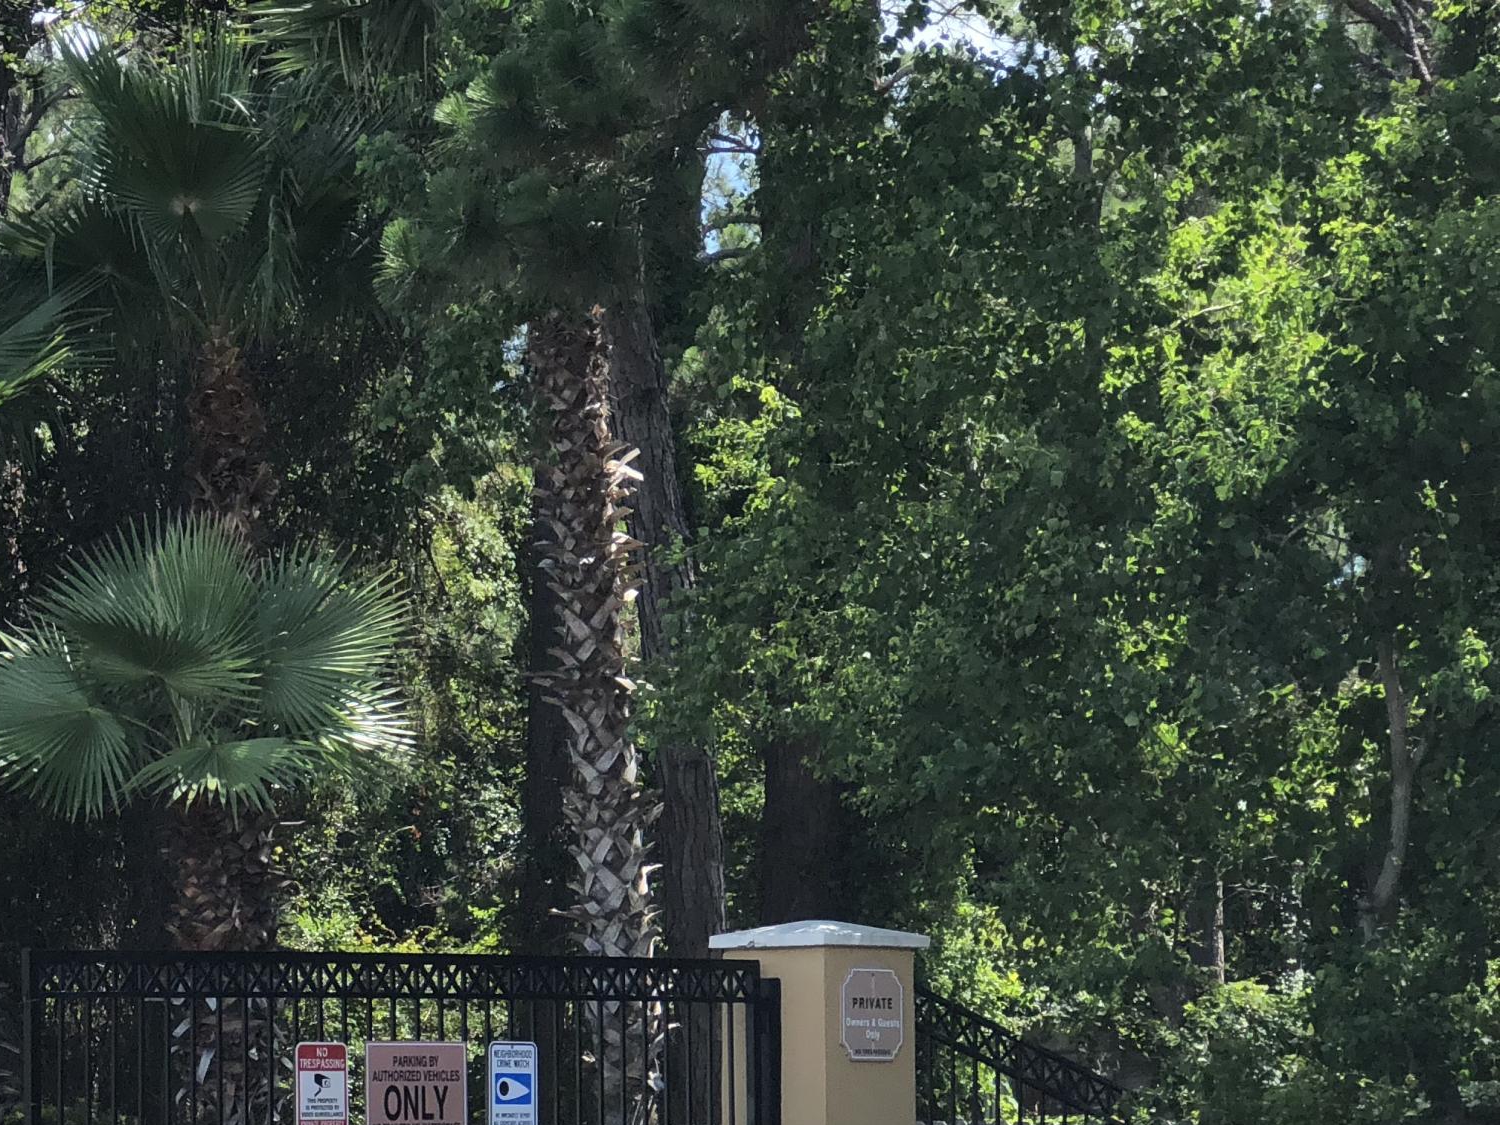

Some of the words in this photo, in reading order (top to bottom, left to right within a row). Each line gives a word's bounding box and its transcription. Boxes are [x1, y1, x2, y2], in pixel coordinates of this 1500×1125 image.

[852, 997, 892, 1009] PRIVATE
[846, 1017, 870, 1027] Owners
[878, 1018, 900, 1028] Guests
[866, 1029, 880, 1041] Only
[316, 1047, 328, 1057] NO
[493, 1049, 532, 1058] NEIGHBORHOOD
[300, 1058, 345, 1069] TRESPASSING
[392, 1055, 427, 1067] PARKING
[429, 1055, 439, 1067] BY
[497, 1059, 511, 1068] CRIME
[513, 1059, 530, 1068] WATCH
[372, 1070, 422, 1082] AUTHORIZED
[423, 1070, 461, 1082] VEHICLES
[384, 1084, 449, 1121] ONLY
